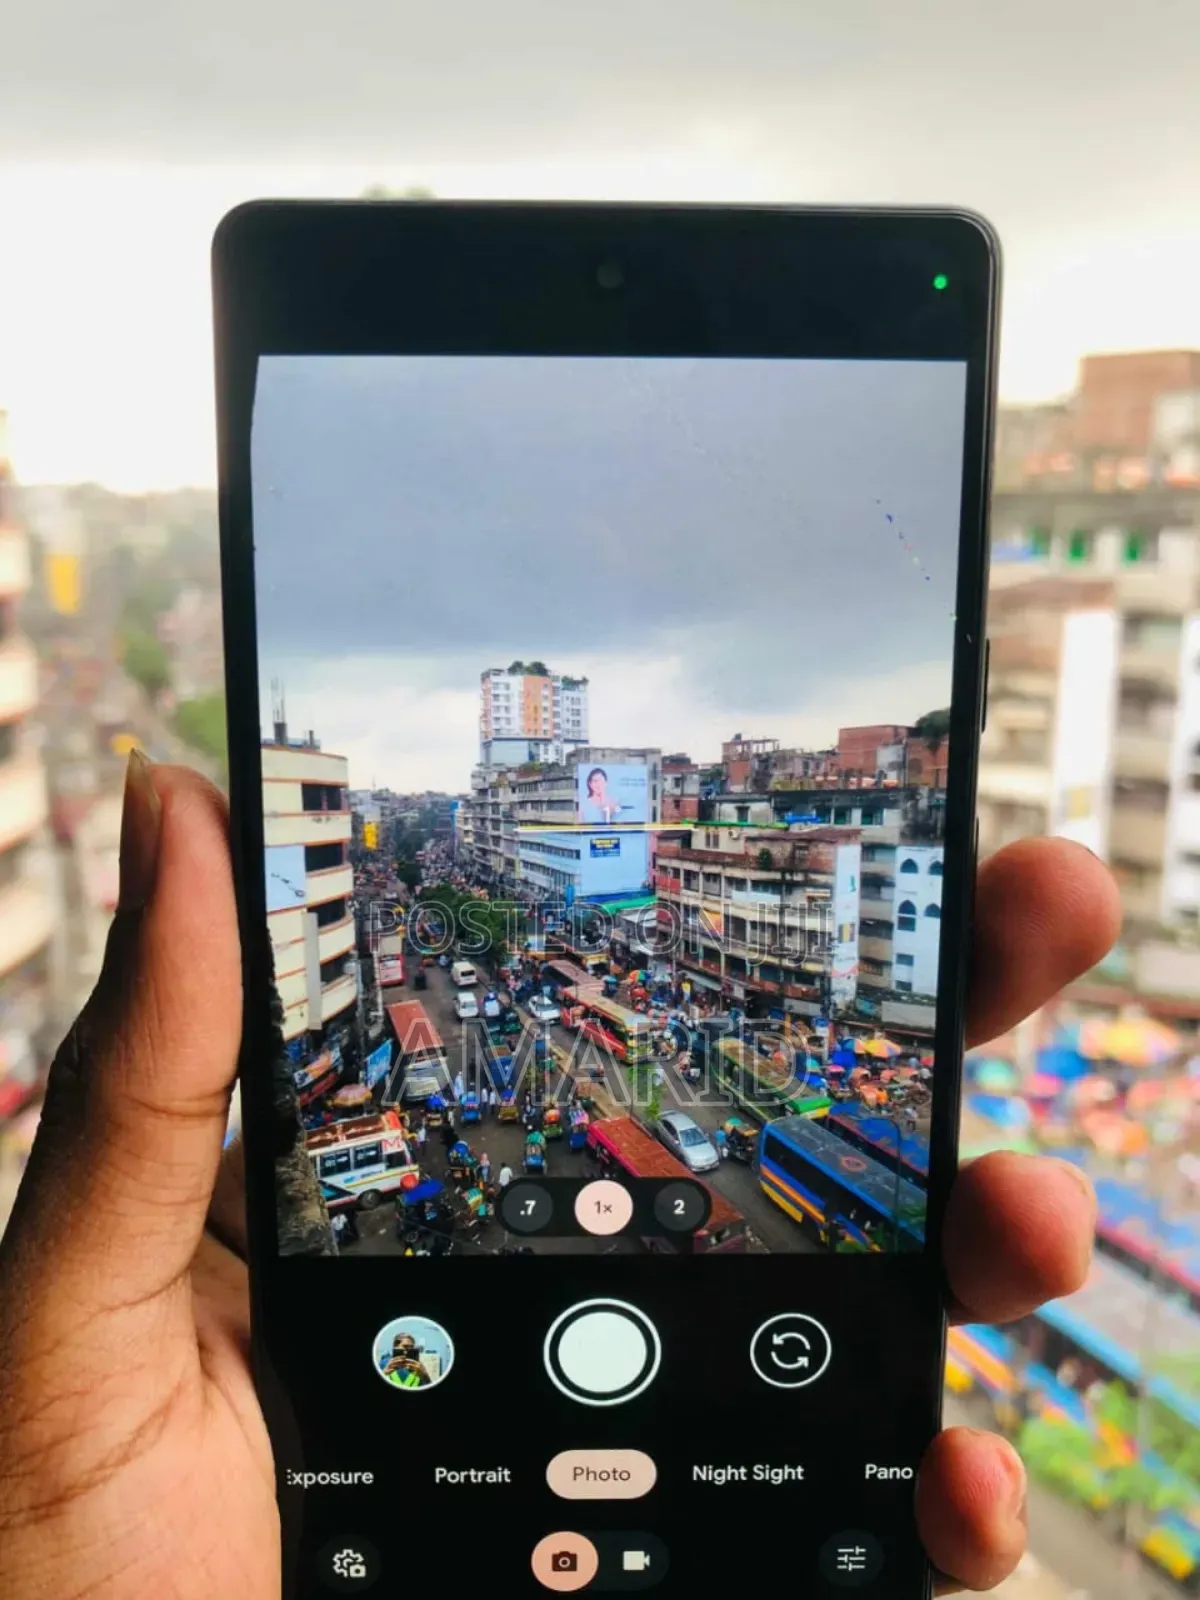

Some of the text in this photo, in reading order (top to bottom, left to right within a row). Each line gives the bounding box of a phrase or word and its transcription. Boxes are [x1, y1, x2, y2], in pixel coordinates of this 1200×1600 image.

[519, 1199, 536, 1216] .7
[673, 1199, 686, 1215] 2
[434, 1466, 511, 1484] Portrait
[572, 1466, 631, 1482] Photo
[692, 1464, 805, 1487] Night Sight
[864, 1463, 914, 1480] Pano
